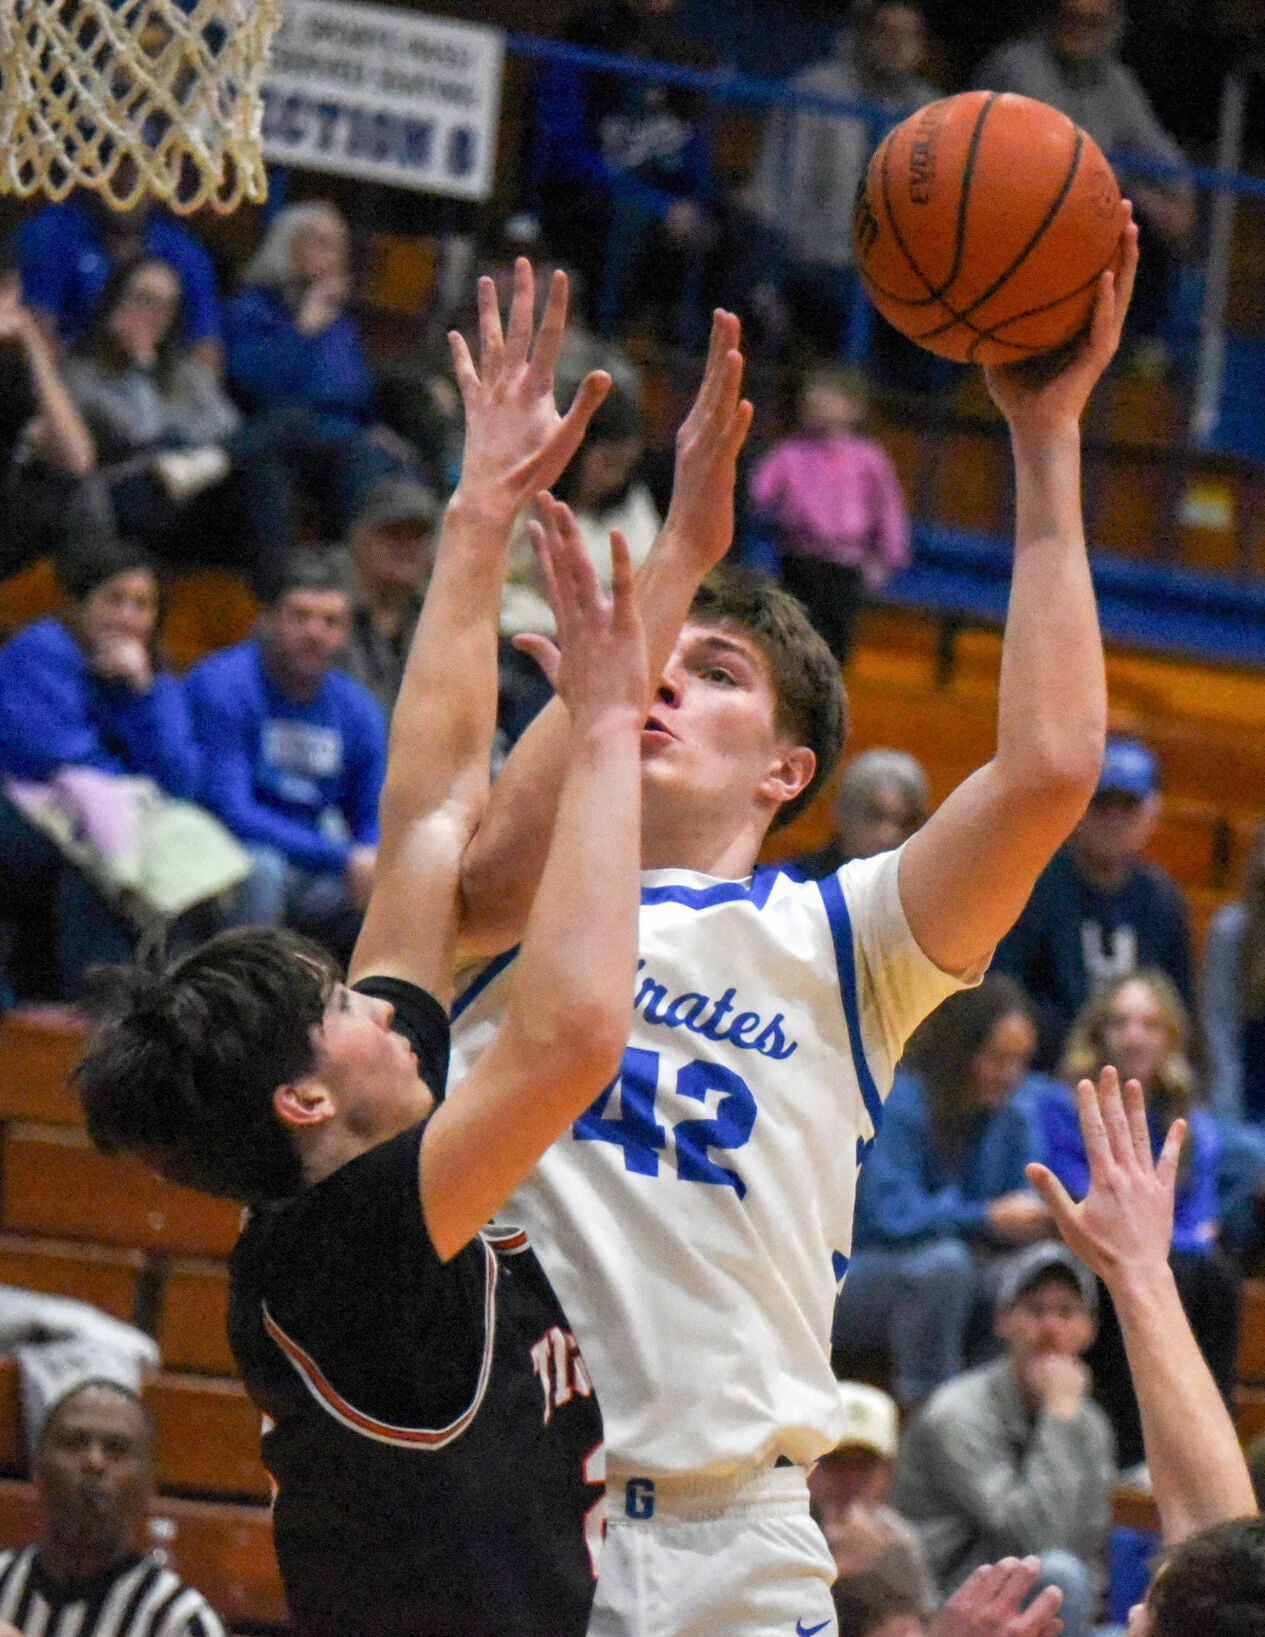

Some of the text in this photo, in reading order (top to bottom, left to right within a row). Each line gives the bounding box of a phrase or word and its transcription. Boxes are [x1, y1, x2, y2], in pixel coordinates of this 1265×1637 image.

[635, 959, 797, 1060] rates
[573, 1046, 757, 1201] 42
[625, 1477, 656, 1520] G
